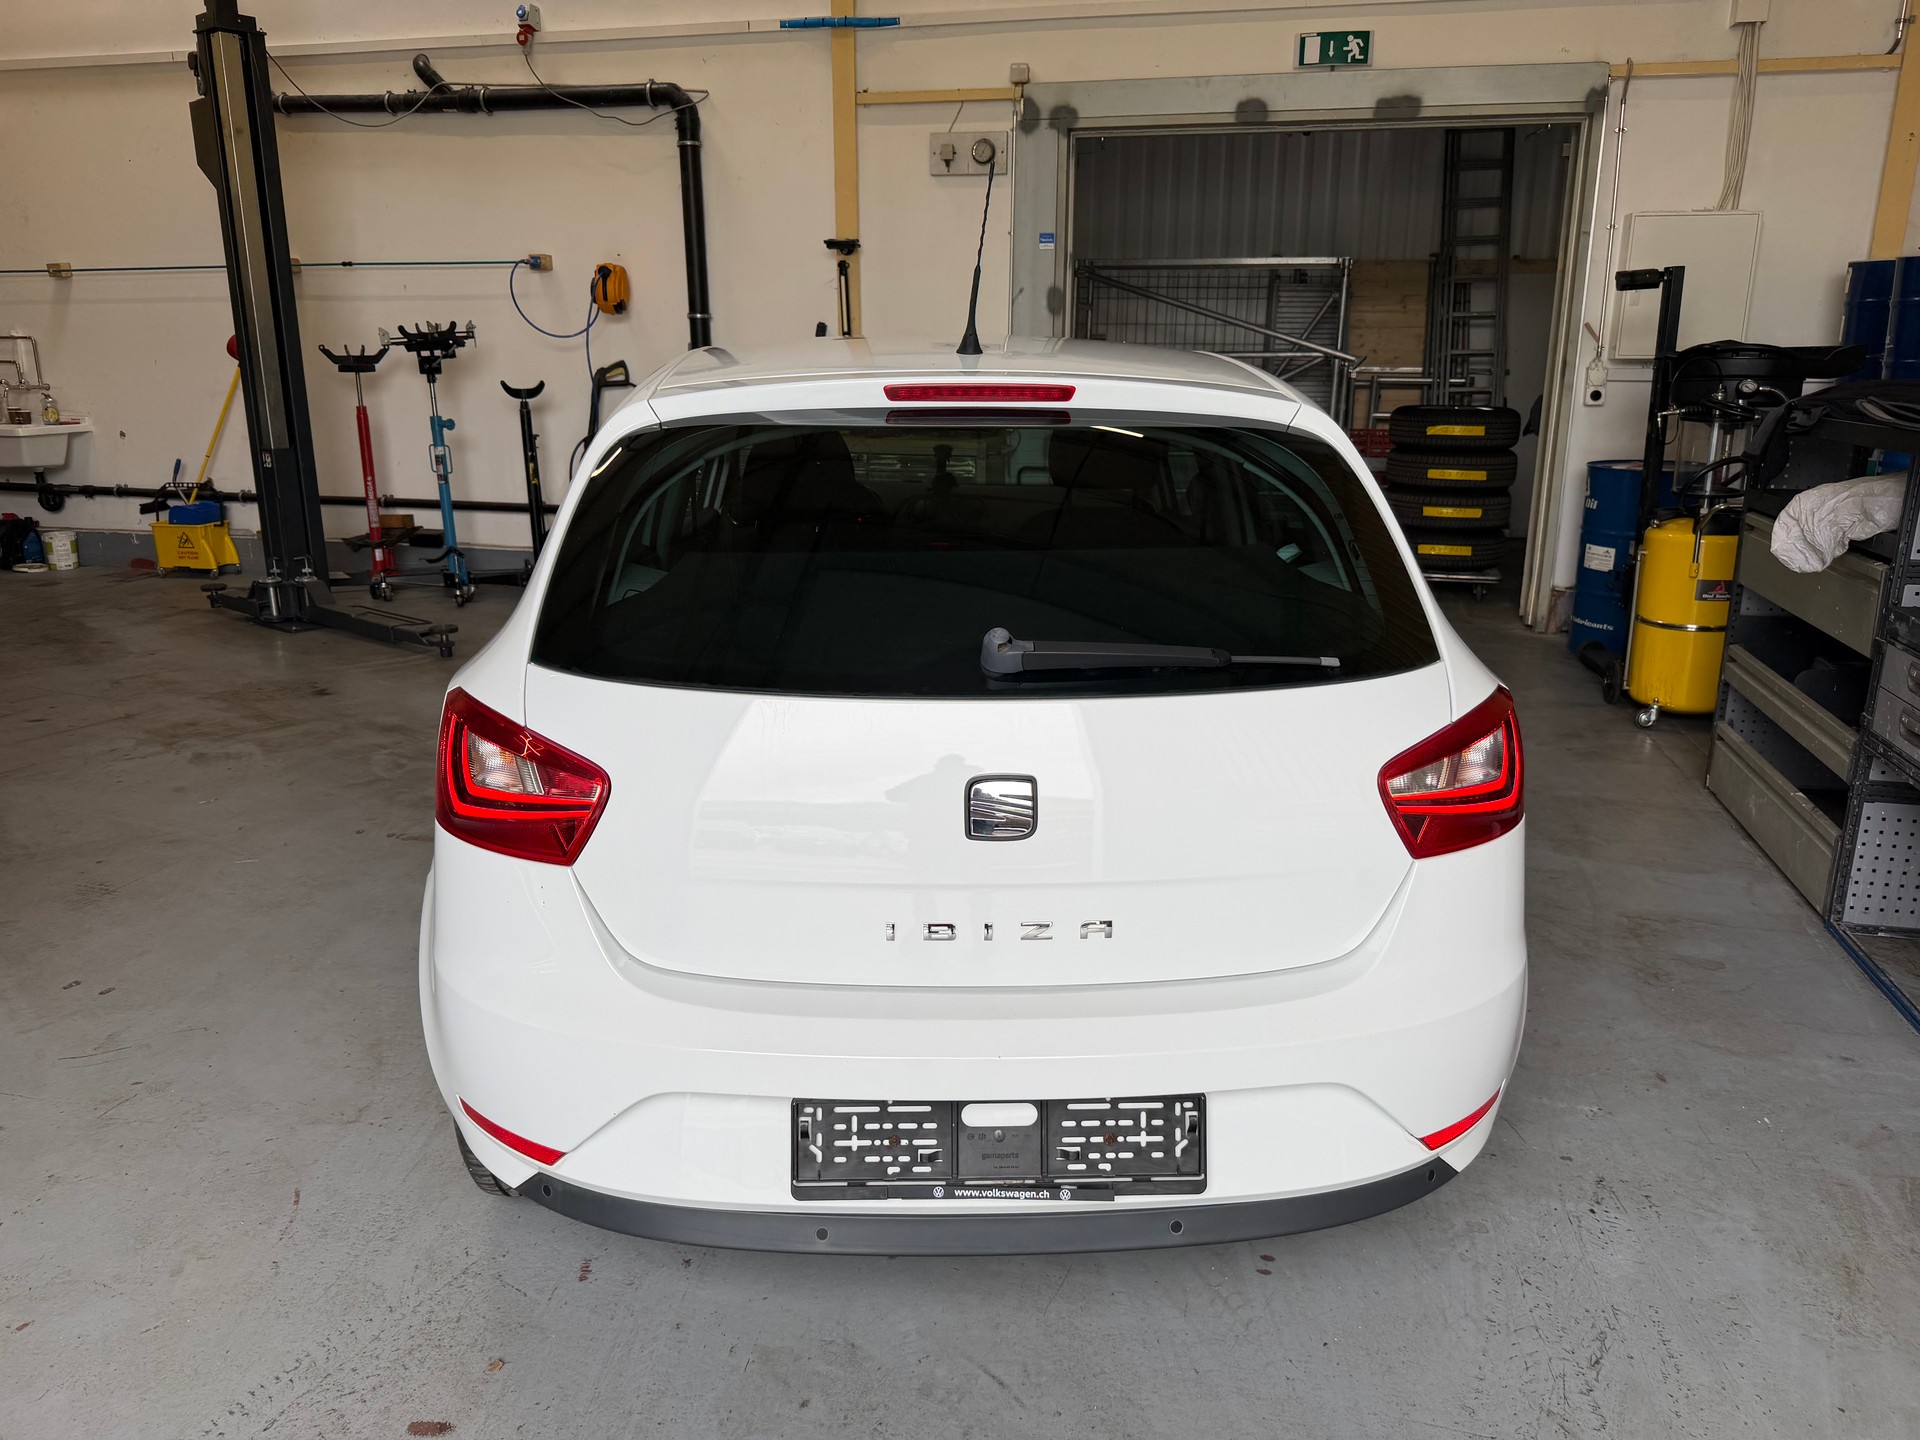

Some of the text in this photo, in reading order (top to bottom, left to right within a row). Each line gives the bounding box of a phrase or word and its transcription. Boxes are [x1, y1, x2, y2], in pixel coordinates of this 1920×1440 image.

[885, 919, 1113, 941] IBIZA
[981, 1152, 1019, 1161] gamaparts
[954, 1188, 1050, 1200] www.volkswagen.ch
